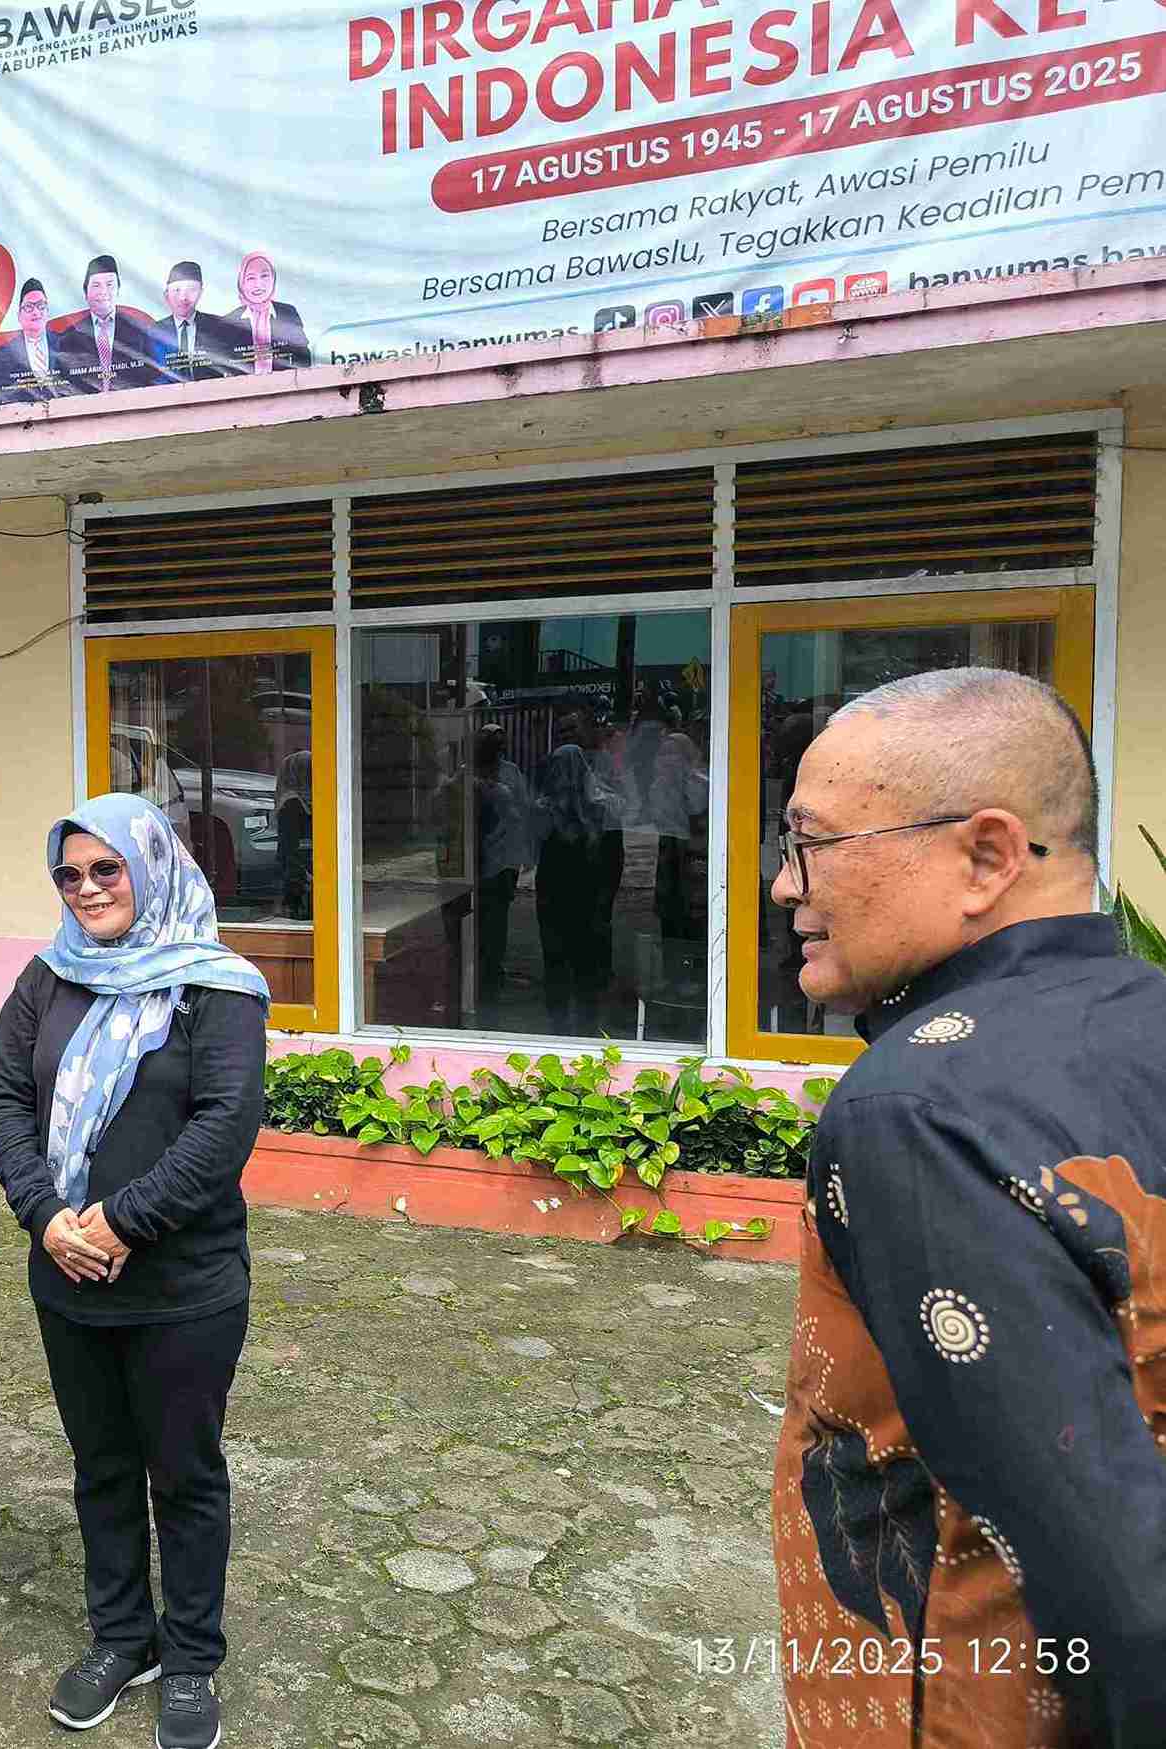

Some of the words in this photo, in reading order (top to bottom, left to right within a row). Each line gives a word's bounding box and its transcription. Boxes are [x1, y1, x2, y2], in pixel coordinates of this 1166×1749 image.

[33, 34, 94, 52] PENGAWAS
[98, 19, 158, 38] PEMILIHAN
[162, 10, 196, 24] UMUM
[99, 21, 199, 54] BANYUMAS
[382, 0, 914, 155] INDONESIA
[471, 165, 507, 193] 17
[515, 137, 671, 189] AGUSTUS
[682, 120, 763, 159] 1945
[799, 106, 840, 138] 17
[850, 72, 1032, 129] AGUSTUS
[1043, 52, 1142, 97] 2025
[423, 262, 555, 301] Bersama
[566, 238, 706, 280] Bawaslu,
[719, 212, 884, 258] Tegakkan
[897, 184, 1062, 231] Keadilan
[542, 203, 678, 243] Bersama
[689, 179, 803, 219] Rakyat,
[815, 158, 917, 199] Awasi
[929, 141, 1050, 182] Pemilu
